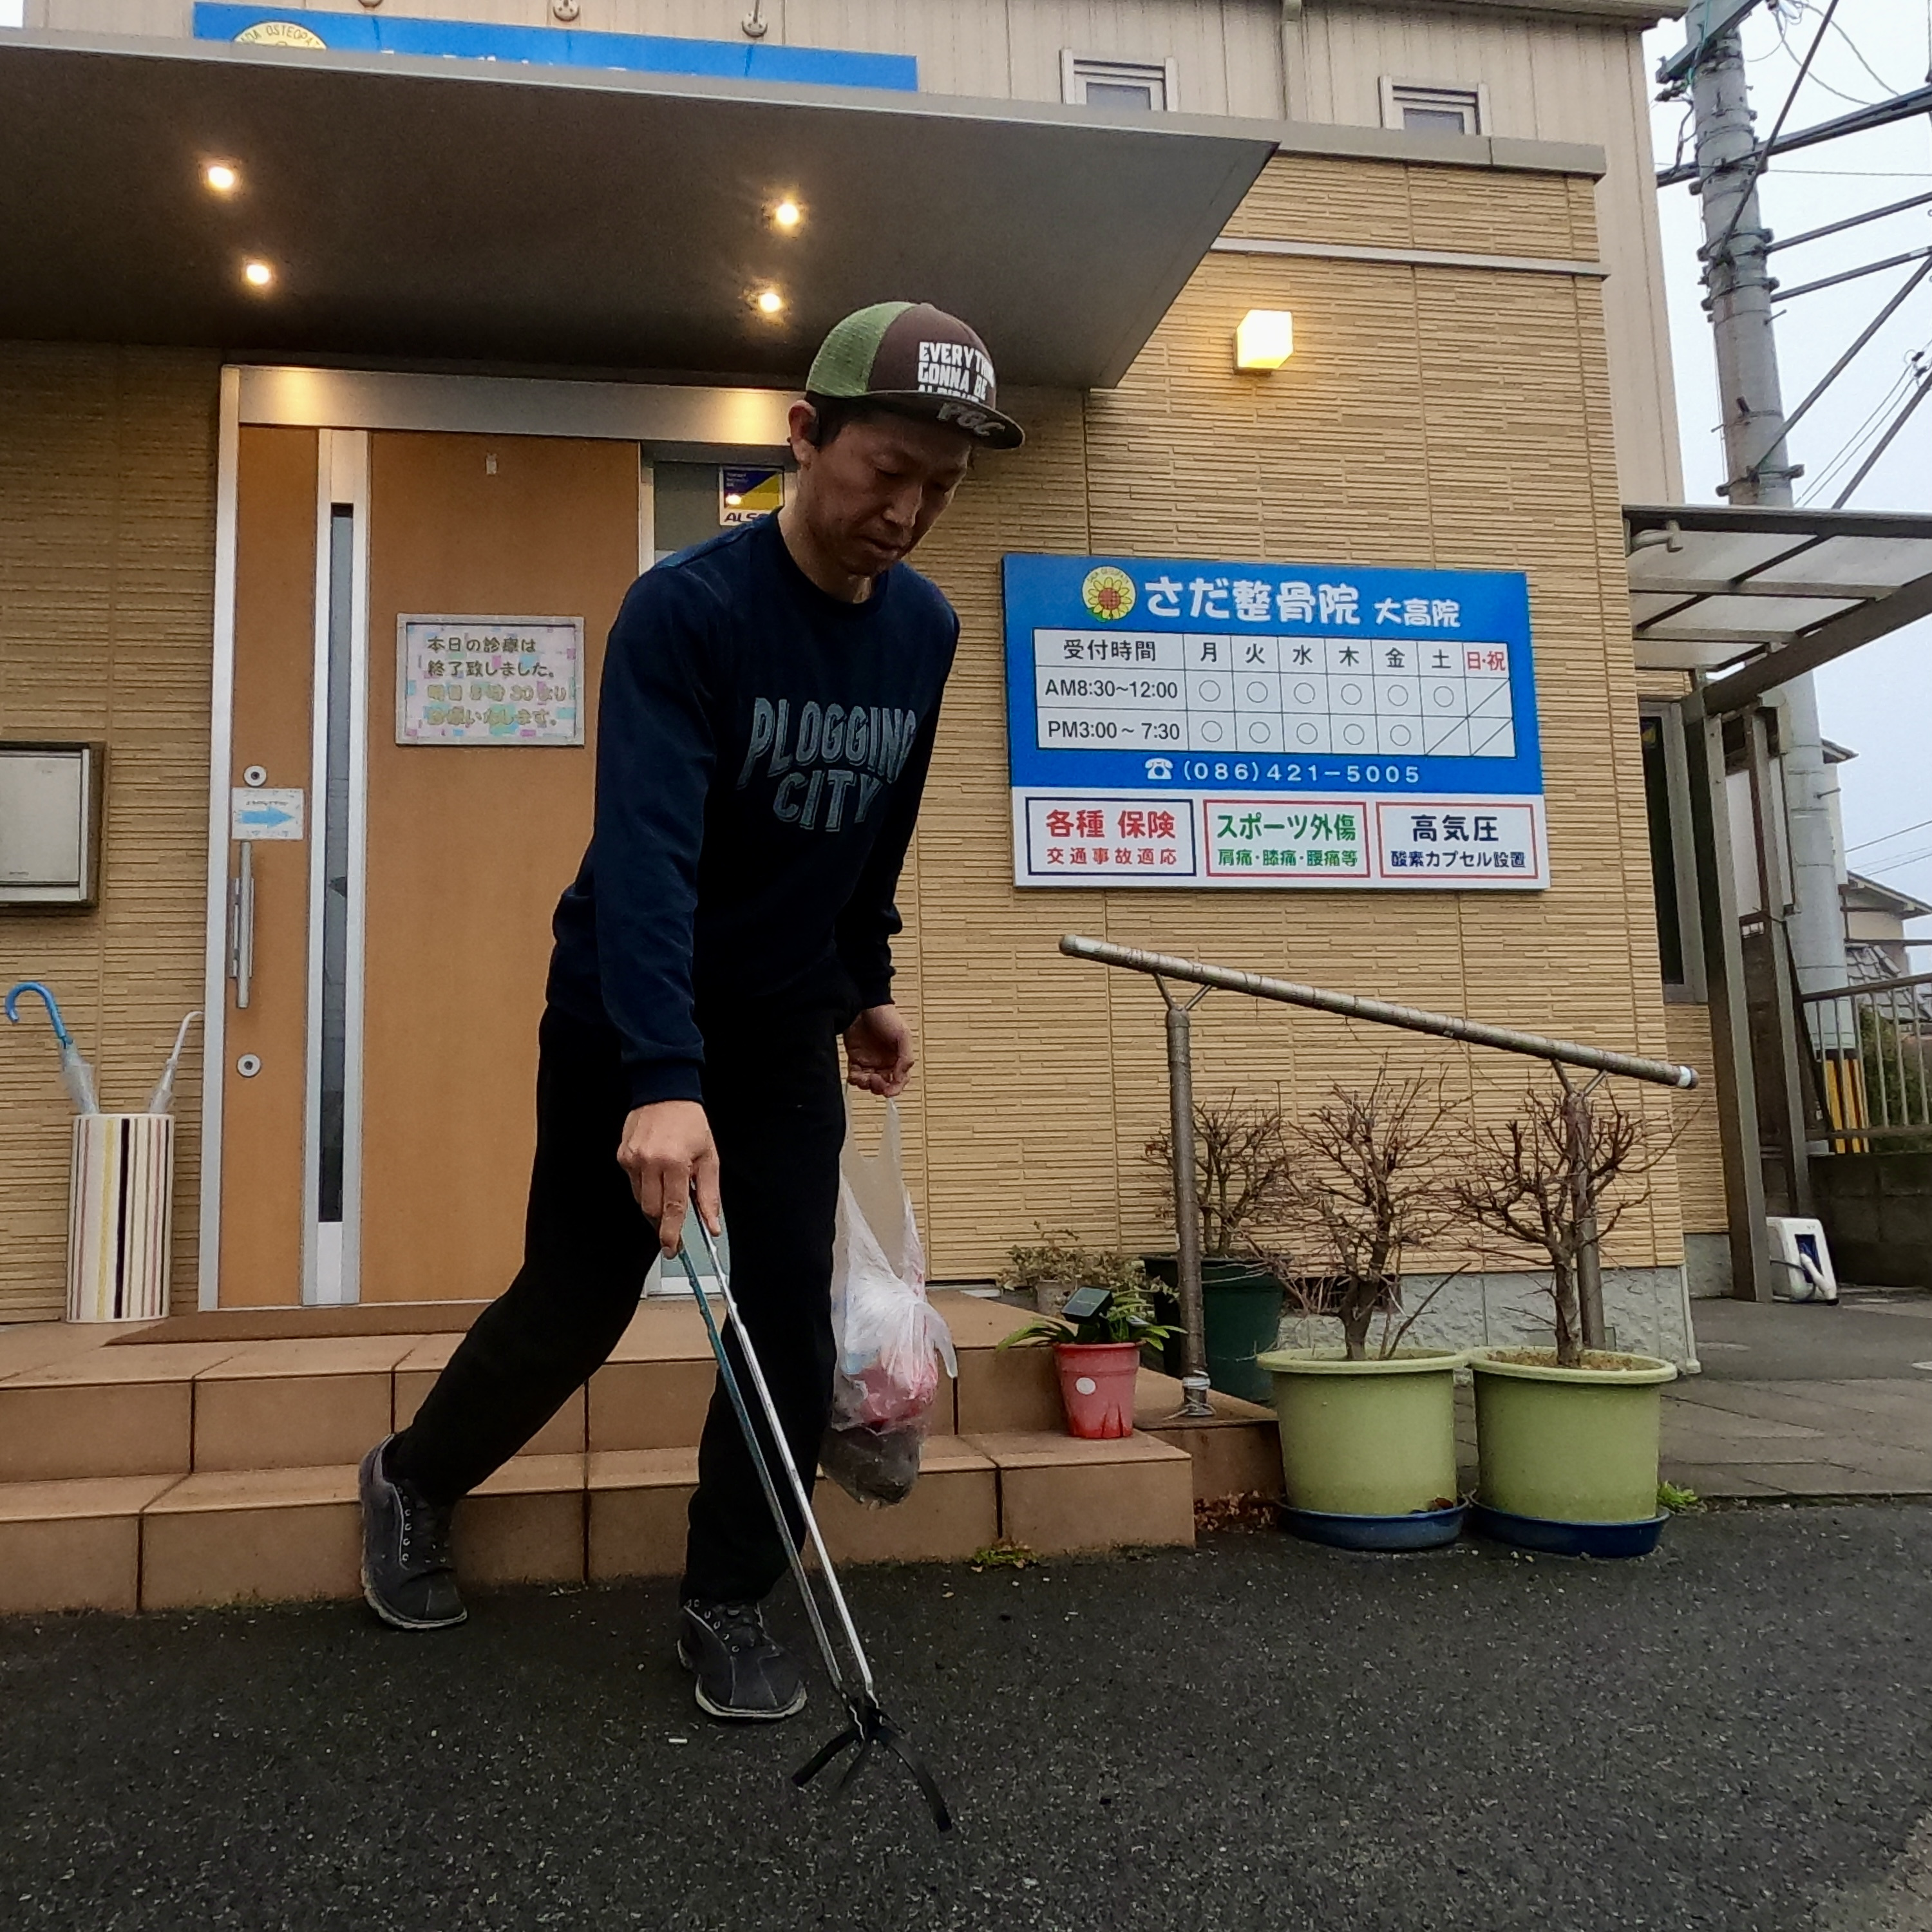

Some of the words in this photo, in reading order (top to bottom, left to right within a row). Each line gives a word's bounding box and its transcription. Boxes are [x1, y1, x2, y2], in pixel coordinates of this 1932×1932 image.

[919, 341, 994, 388] EVERYTH
[918, 361, 970, 393] GONNA
[973, 374, 987, 401] BE
[1145, 576, 1360, 625] さだ整骨院
[1374, 598, 1461, 628] 大高院
[1063, 639, 1156, 662] 受付時間
[1200, 642, 1217, 662] 月
[1245, 643, 1265, 664] 火
[1293, 645, 1313, 665] 水
[1339, 646, 1359, 667] 木
[1385, 647, 1405, 668] 金
[1432, 649, 1452, 668] 土
[737, 697, 916, 790] PLOGGING
[773, 770, 884, 831] CITY
[1046, 810, 1105, 838] 各種
[1117, 810, 1176, 838] 保険
[1217, 811, 1356, 841] スポーツ外傷
[1411, 814, 1499, 842] 高気圧
[1046, 847, 1177, 864] 交通事故適応
[1390, 850, 1526, 868] 酸素カプセル設置
